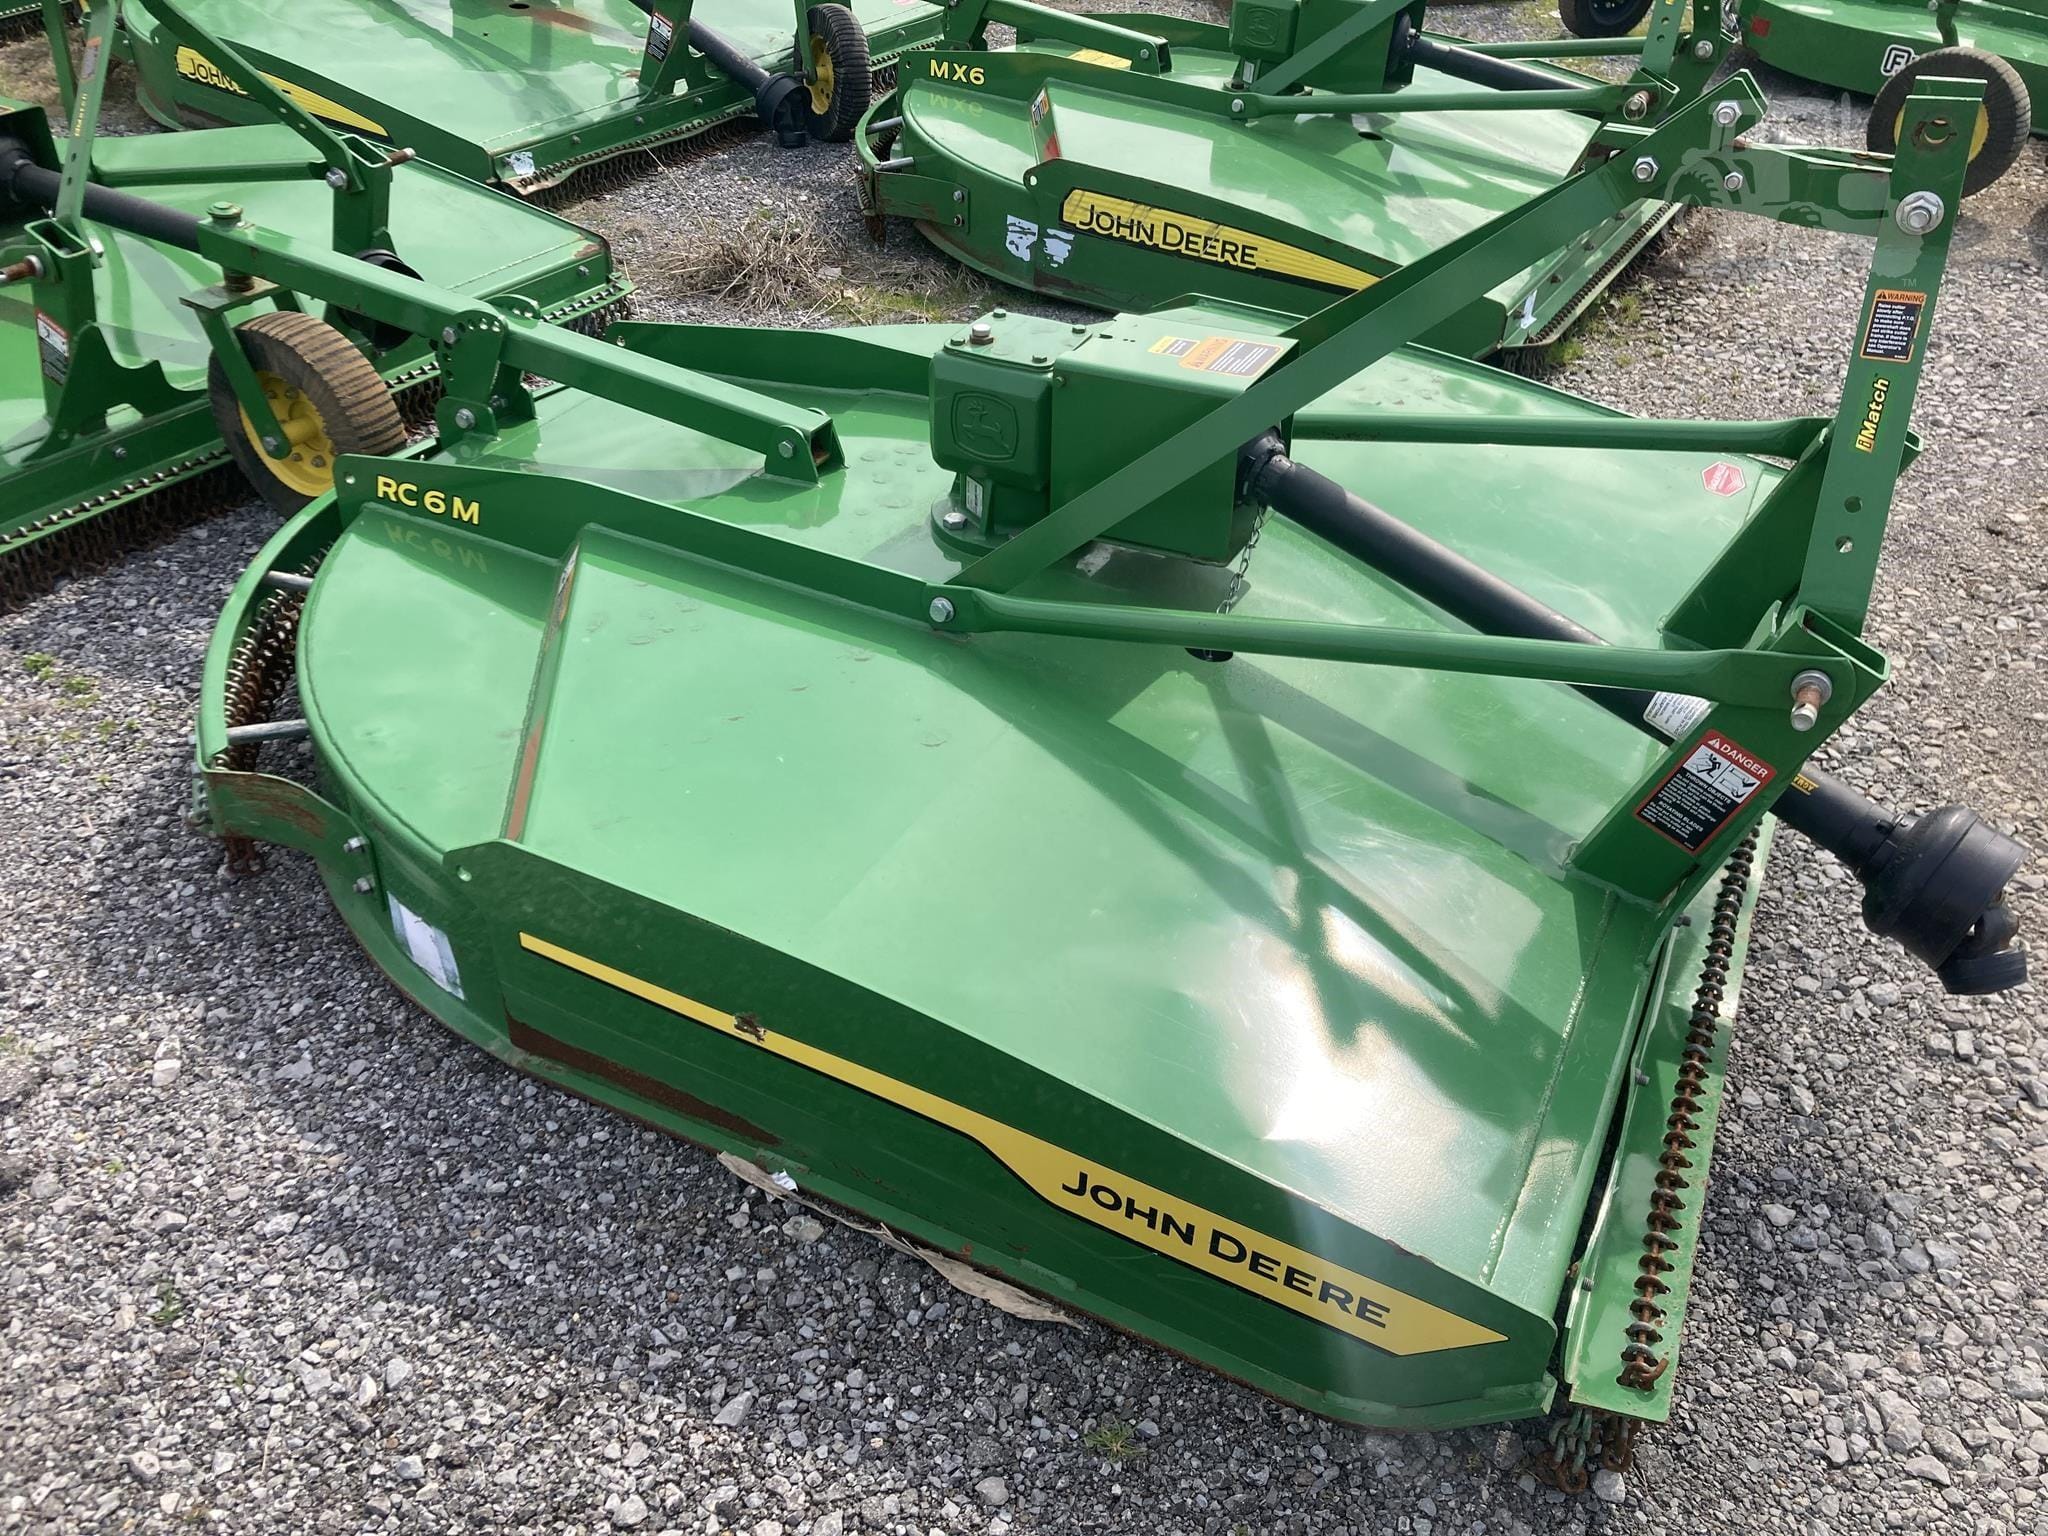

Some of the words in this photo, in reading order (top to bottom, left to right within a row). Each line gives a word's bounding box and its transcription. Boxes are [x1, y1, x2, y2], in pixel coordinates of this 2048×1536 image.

[930, 58, 985, 85] MX6
[1079, 204, 1155, 242] JOHN
[1162, 222, 1259, 266] DEERE
[1887, 292, 1925, 303] WARNING
[1855, 377, 1890, 453] iMatch
[1719, 743, 1769, 778] DANGER
[1684, 772, 1708, 789] THROWN
[1706, 786, 1731, 804] OBJECTS
[1658, 800, 1683, 818] ROTATING
[1682, 816, 1704, 832] BLADES
[1061, 1171, 1196, 1246] JOHN
[1208, 1228, 1391, 1329] DEERE
